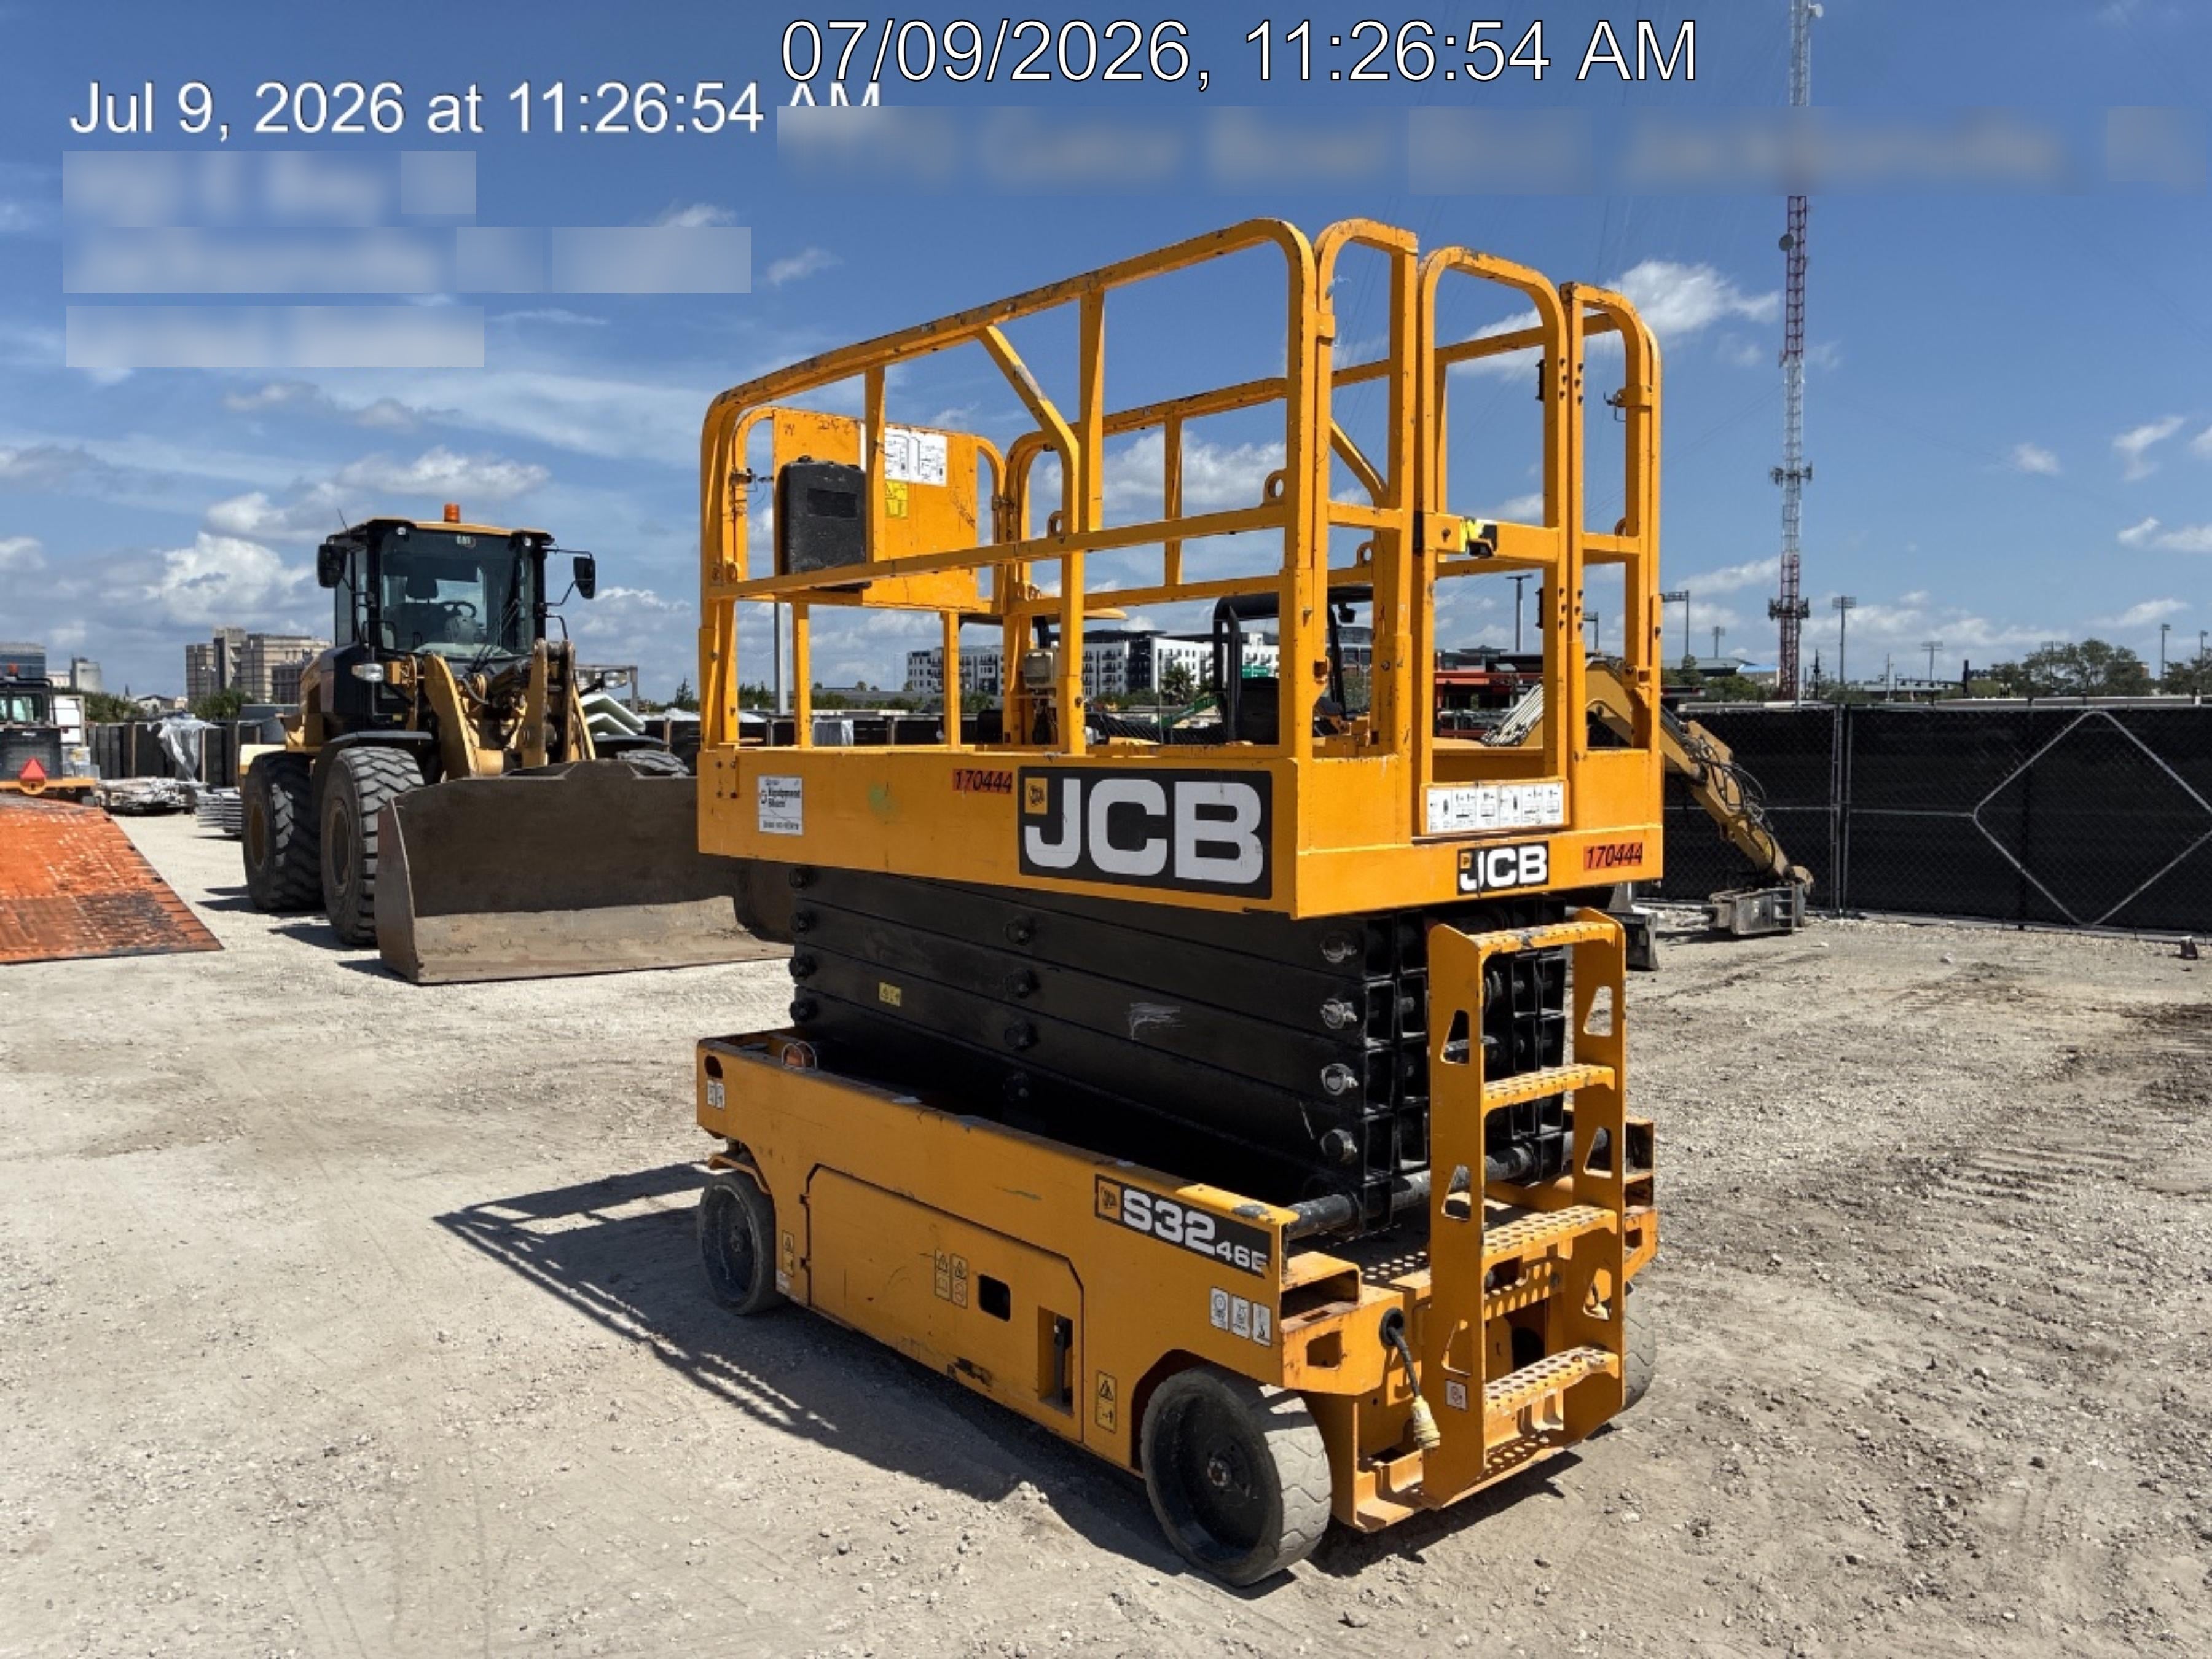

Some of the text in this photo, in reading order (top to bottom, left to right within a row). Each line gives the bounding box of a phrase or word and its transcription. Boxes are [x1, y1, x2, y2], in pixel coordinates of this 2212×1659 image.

[955, 769, 1013, 794] 170444
[1024, 777, 1264, 884] JCB
[1459, 845, 1548, 891] JCB
[1586, 842, 1643, 869] 170444
